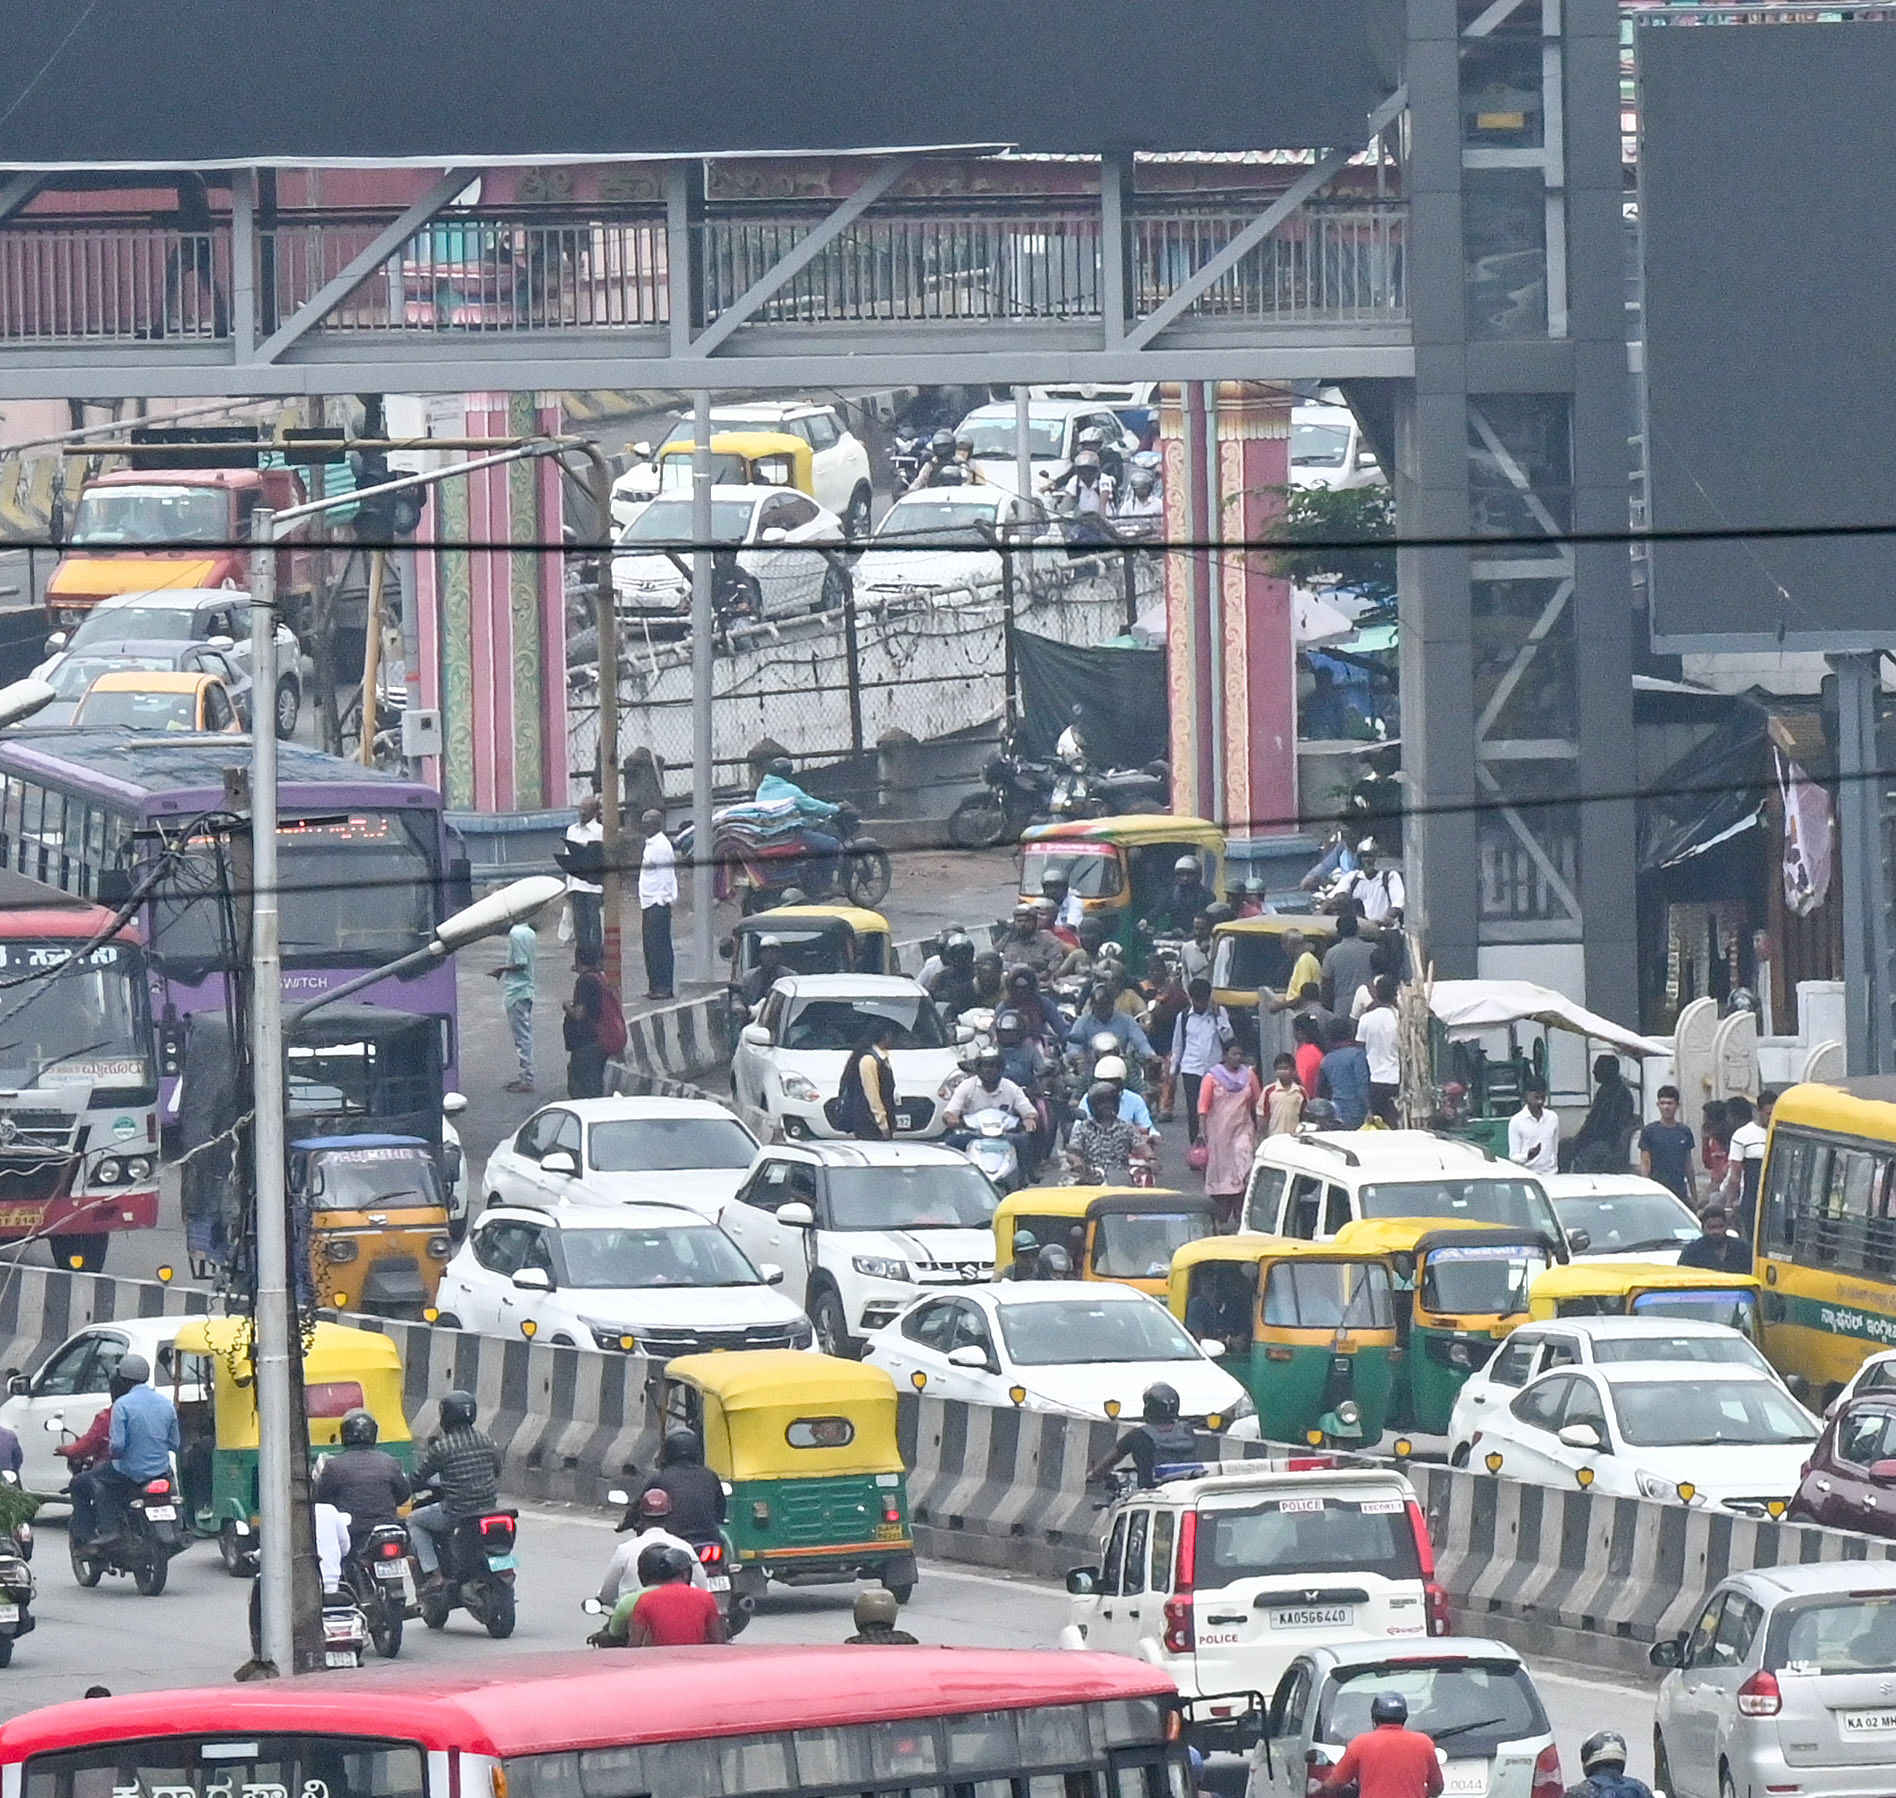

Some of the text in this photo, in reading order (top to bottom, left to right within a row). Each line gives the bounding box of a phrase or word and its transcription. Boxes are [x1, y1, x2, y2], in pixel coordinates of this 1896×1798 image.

[1282, 1501, 1321, 1512] POLICE
[1279, 1610, 1346, 1625] KA05G6440
[1199, 1635, 1239, 1645] POLICE
[1848, 1719, 1863, 1729] KA
[1866, 1718, 1878, 1728] 02
